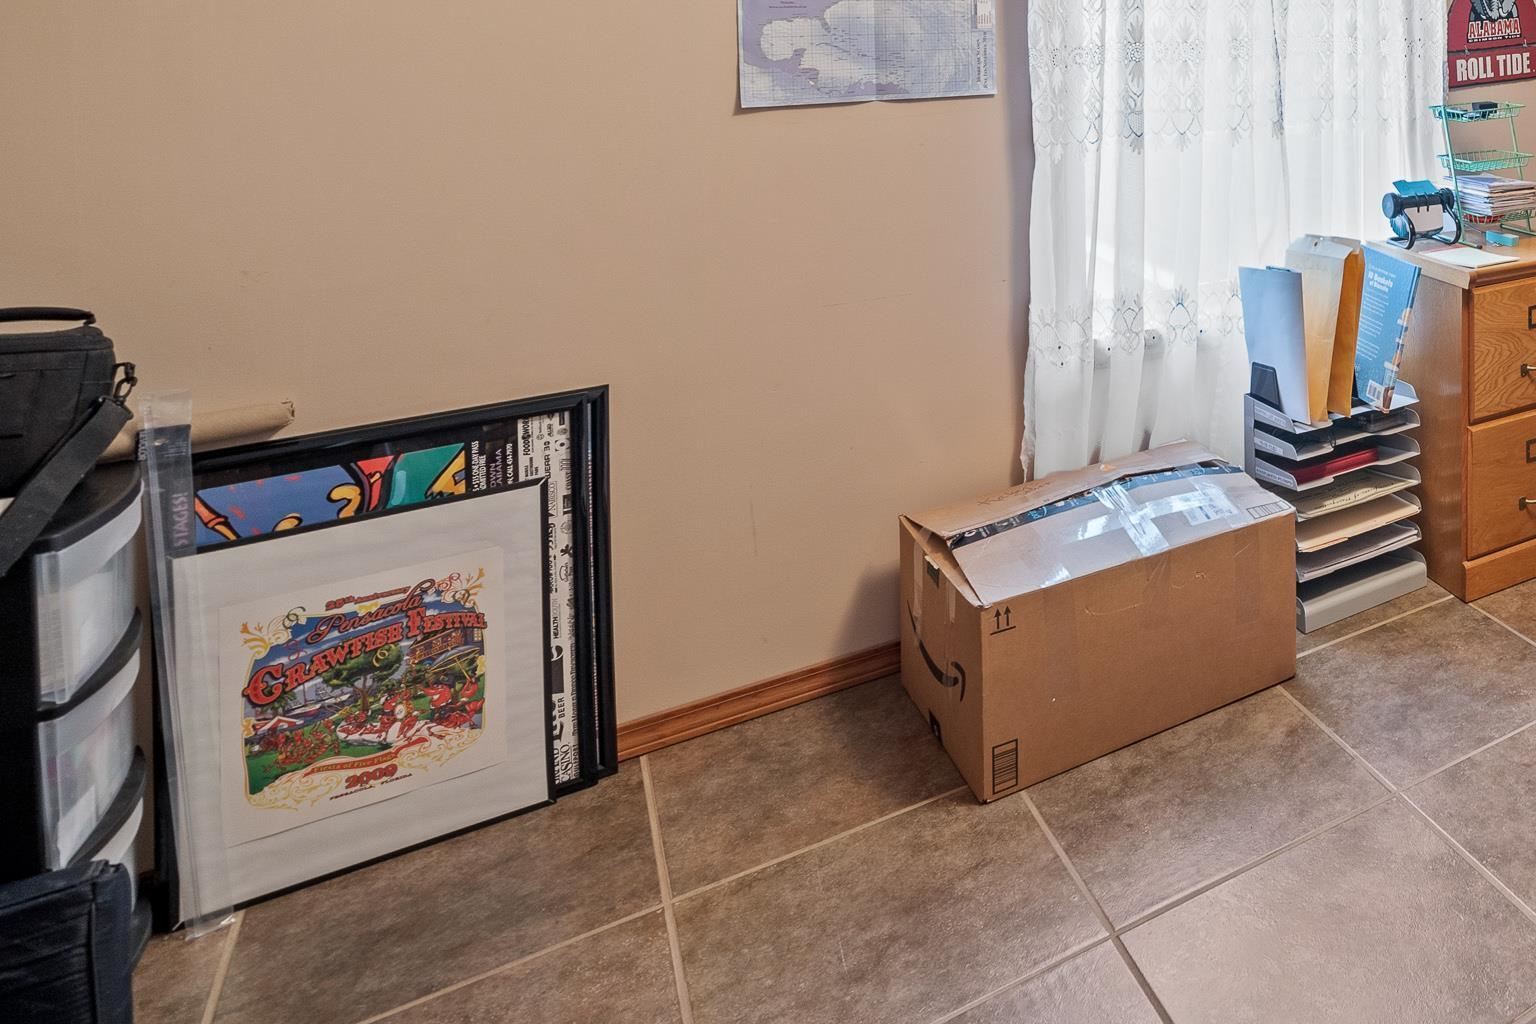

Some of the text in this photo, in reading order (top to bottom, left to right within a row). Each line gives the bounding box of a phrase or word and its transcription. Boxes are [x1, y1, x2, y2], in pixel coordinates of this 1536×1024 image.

[1468, 18, 1521, 39] ALABAMA
[1456, 52, 1530, 81] ROLL TIDE
[523, 439, 531, 455] FOOD
[172, 492, 189, 547] STAGES!
[307, 578, 436, 643] Pensacola
[241, 607, 488, 705] CRAWFISH FESTIVAL
[557, 696, 566, 719] BEER
[344, 763, 398, 789] 2009
[560, 743, 572, 783] CASINO
